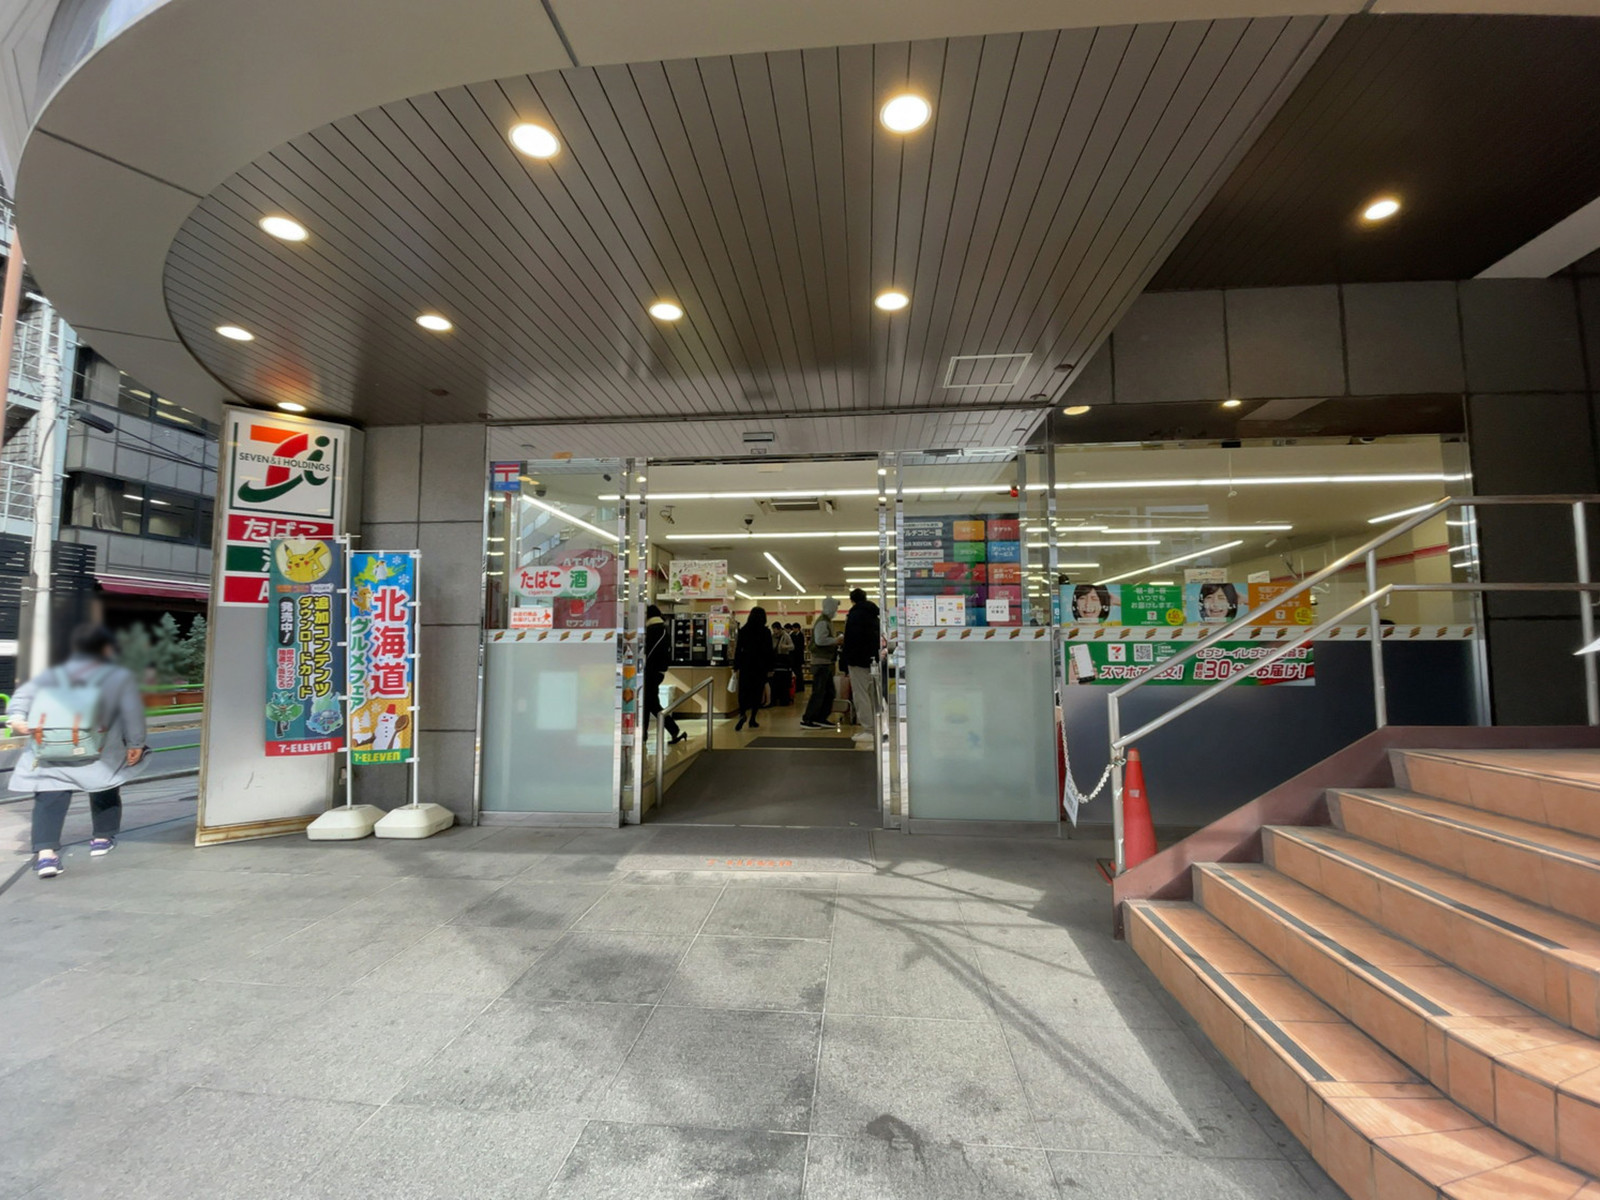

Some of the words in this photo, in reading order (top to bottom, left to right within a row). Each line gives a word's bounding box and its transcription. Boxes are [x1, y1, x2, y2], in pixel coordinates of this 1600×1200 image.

[283, 458, 331, 472] HOLDINGS
[903, 529, 942, 537] ルチコピー
[520, 571, 562, 589] たばこ
[569, 570, 588, 589] 酒
[299, 596, 313, 698] ダウンロードカード
[313, 596, 330, 697] 追加コンテンツ
[370, 587, 408, 698] 北海道
[350, 617, 371, 713] グルメフェア
[278, 741, 332, 754] 7-ELEVEN
[354, 751, 401, 763] 7-ELEVEN
